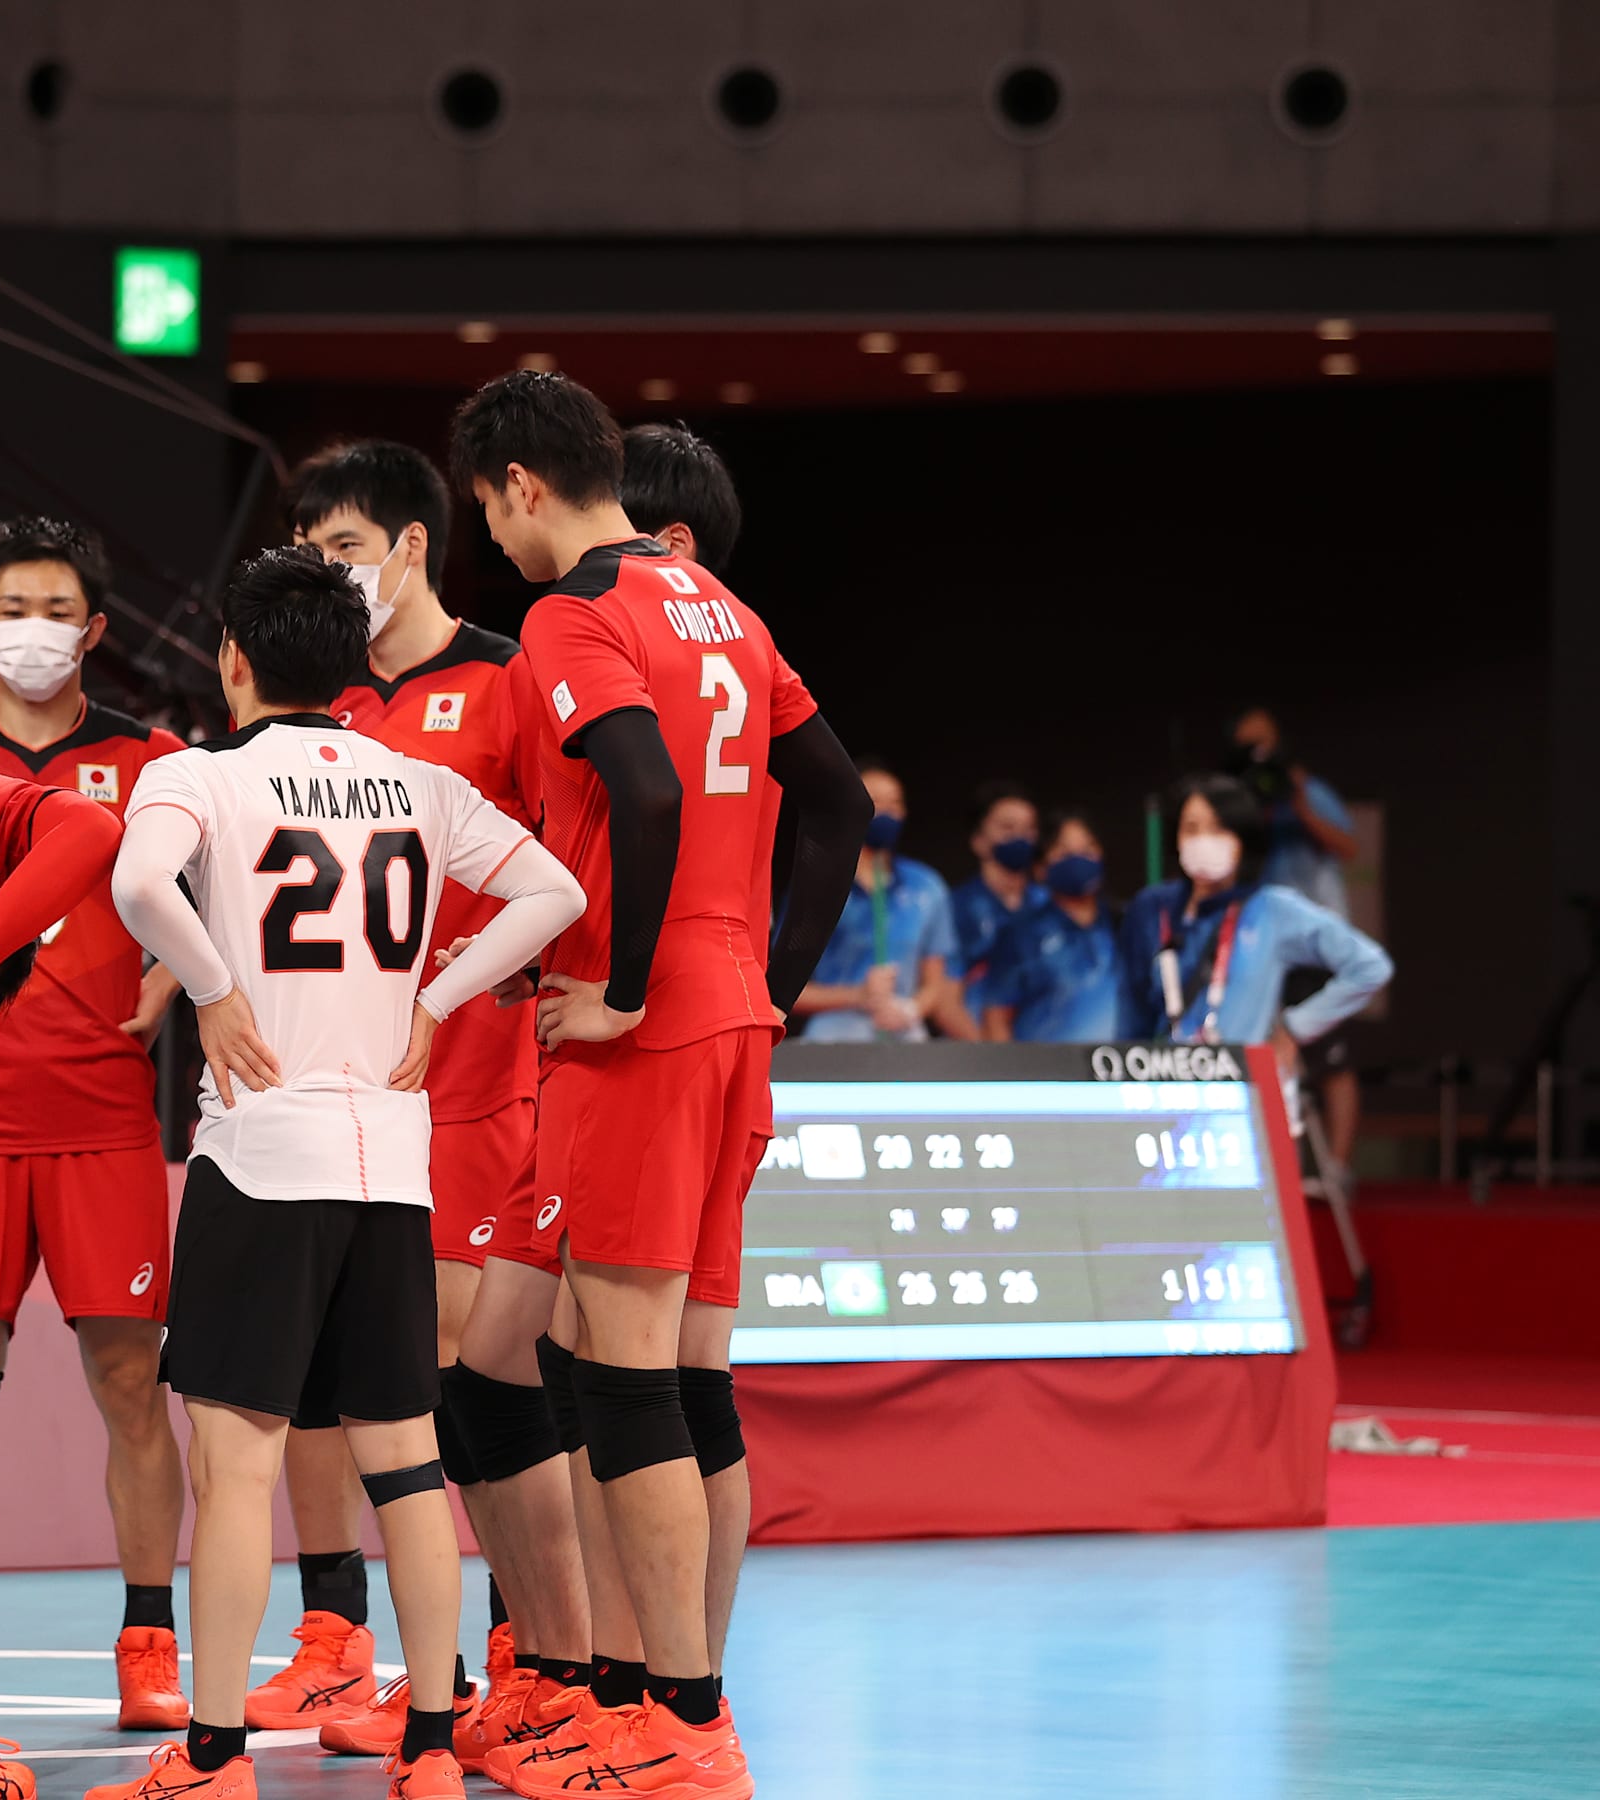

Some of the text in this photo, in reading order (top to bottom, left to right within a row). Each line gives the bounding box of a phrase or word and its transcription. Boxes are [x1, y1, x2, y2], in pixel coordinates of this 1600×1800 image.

[662, 599, 745, 644] ONODERA
[430, 718, 456, 728] JPN
[699, 653, 750, 796] 2
[86, 788, 113, 799] JPN
[268, 776, 412, 819] YAMAMOTO
[253, 825, 430, 974] 20
[1125, 1044, 1242, 1082] OMEGA
[757, 1135, 801, 1170] PN
